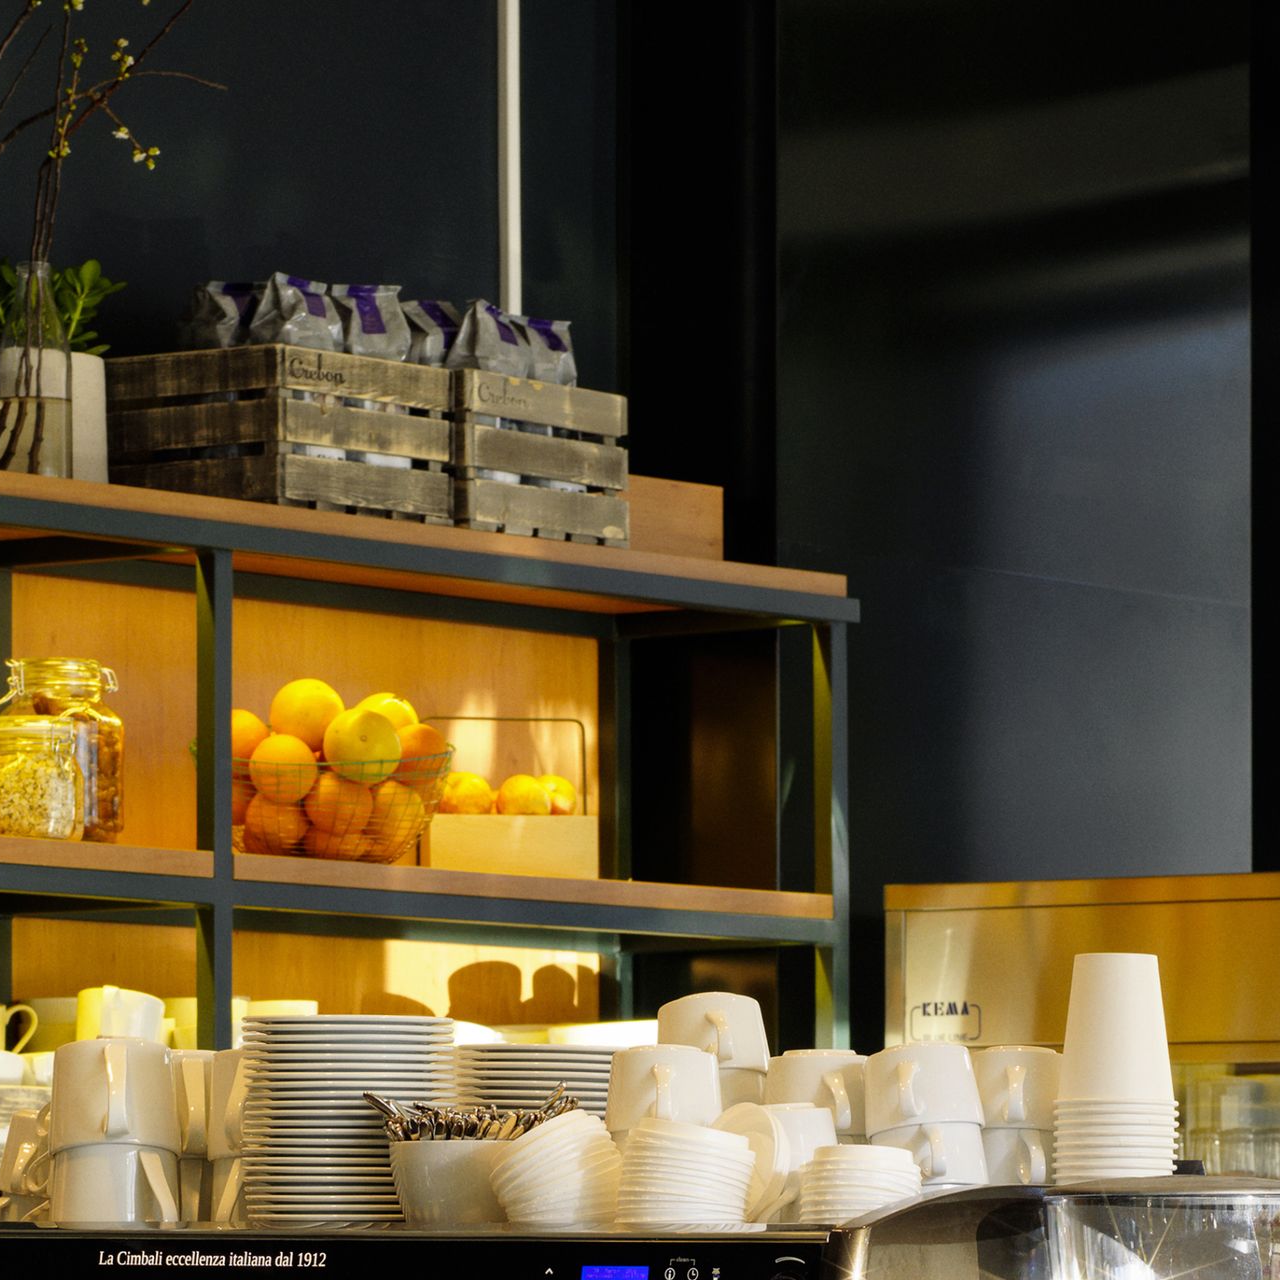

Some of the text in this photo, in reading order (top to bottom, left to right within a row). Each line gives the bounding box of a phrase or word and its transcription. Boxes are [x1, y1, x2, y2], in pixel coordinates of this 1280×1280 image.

[98, 1250, 328, 1268] La Cimbali eccellenza italiana dal 1912
